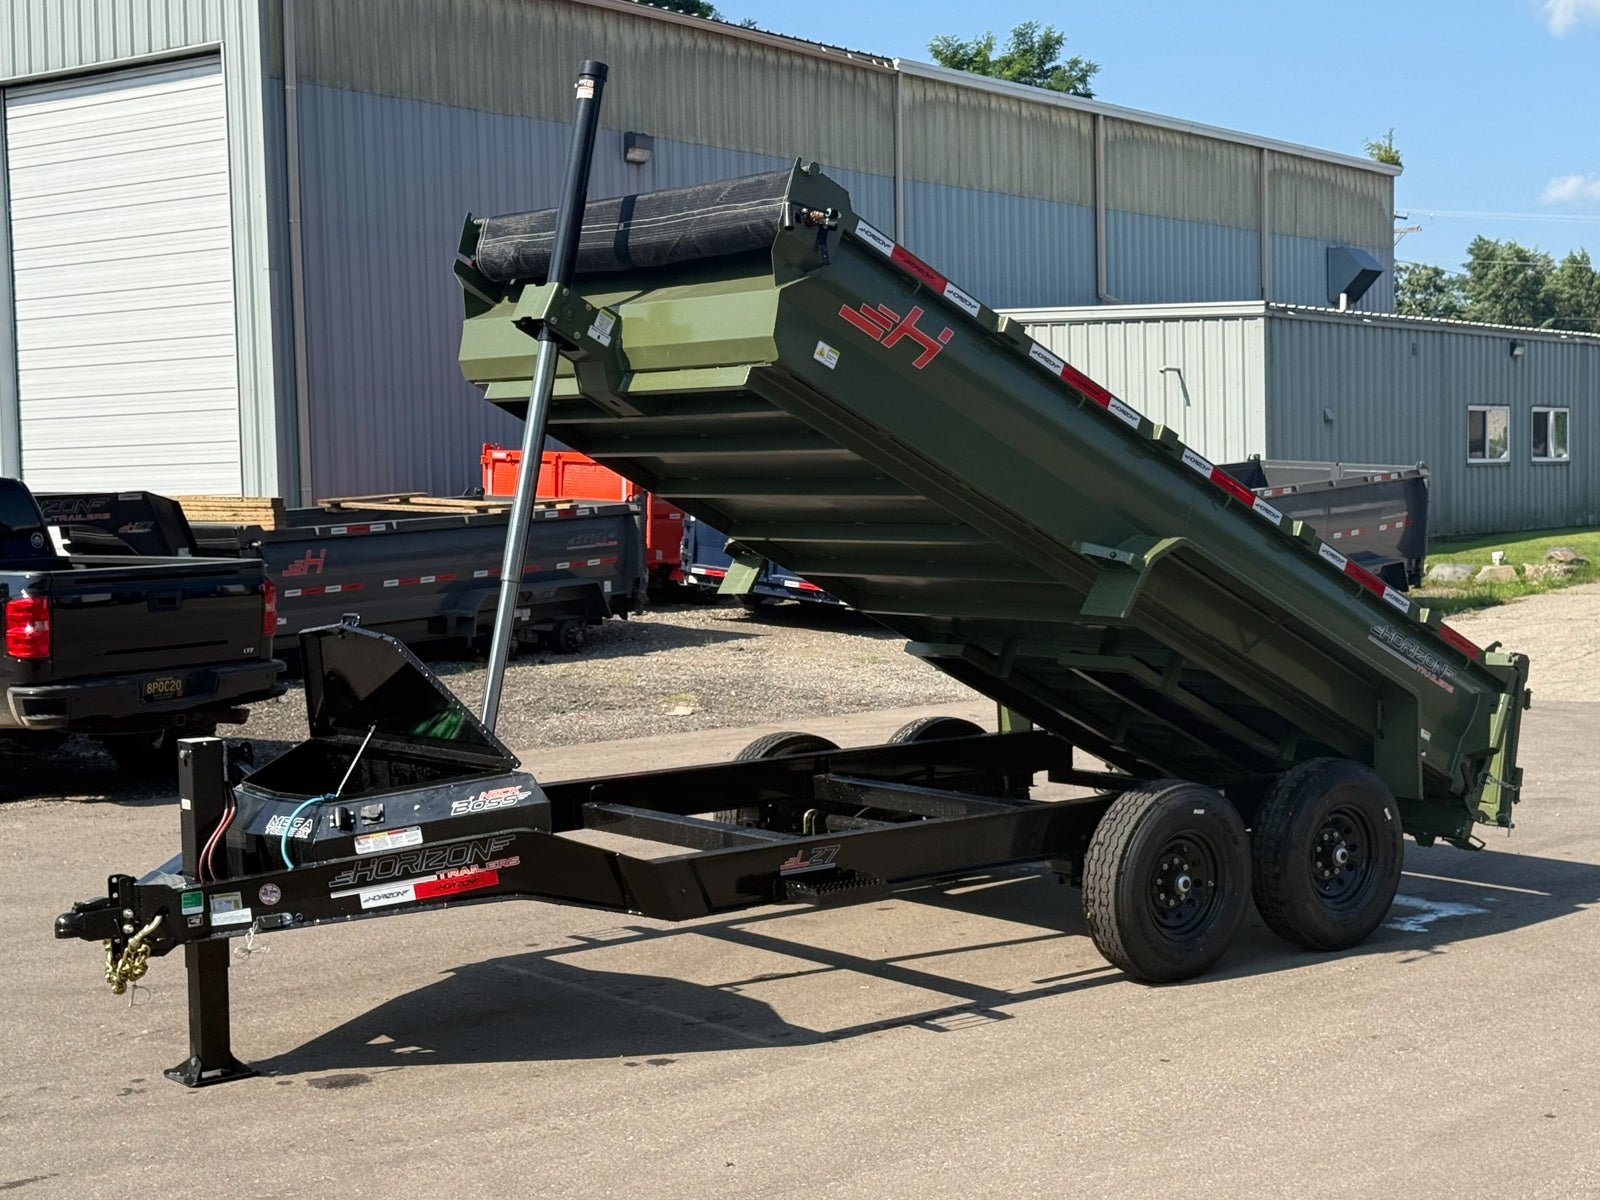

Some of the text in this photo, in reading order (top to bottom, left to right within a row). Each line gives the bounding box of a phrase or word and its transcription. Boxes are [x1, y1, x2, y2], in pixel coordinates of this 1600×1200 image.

[858, 225, 893, 250] HORIZON
[947, 287, 978, 311] HORIZON
[1031, 349, 1062, 372] HORIZON
[1110, 402, 1139, 423] HORIZON
[1373, 624, 1455, 679] HORIZON
[451, 794, 523, 816] BOSS
[265, 814, 314, 833] MEGA
[336, 834, 510, 886] HORIZON
[436, 855, 521, 881] TRAILERS
[362, 888, 410, 904] HORIZON
[433, 877, 481, 893] HORIZON
